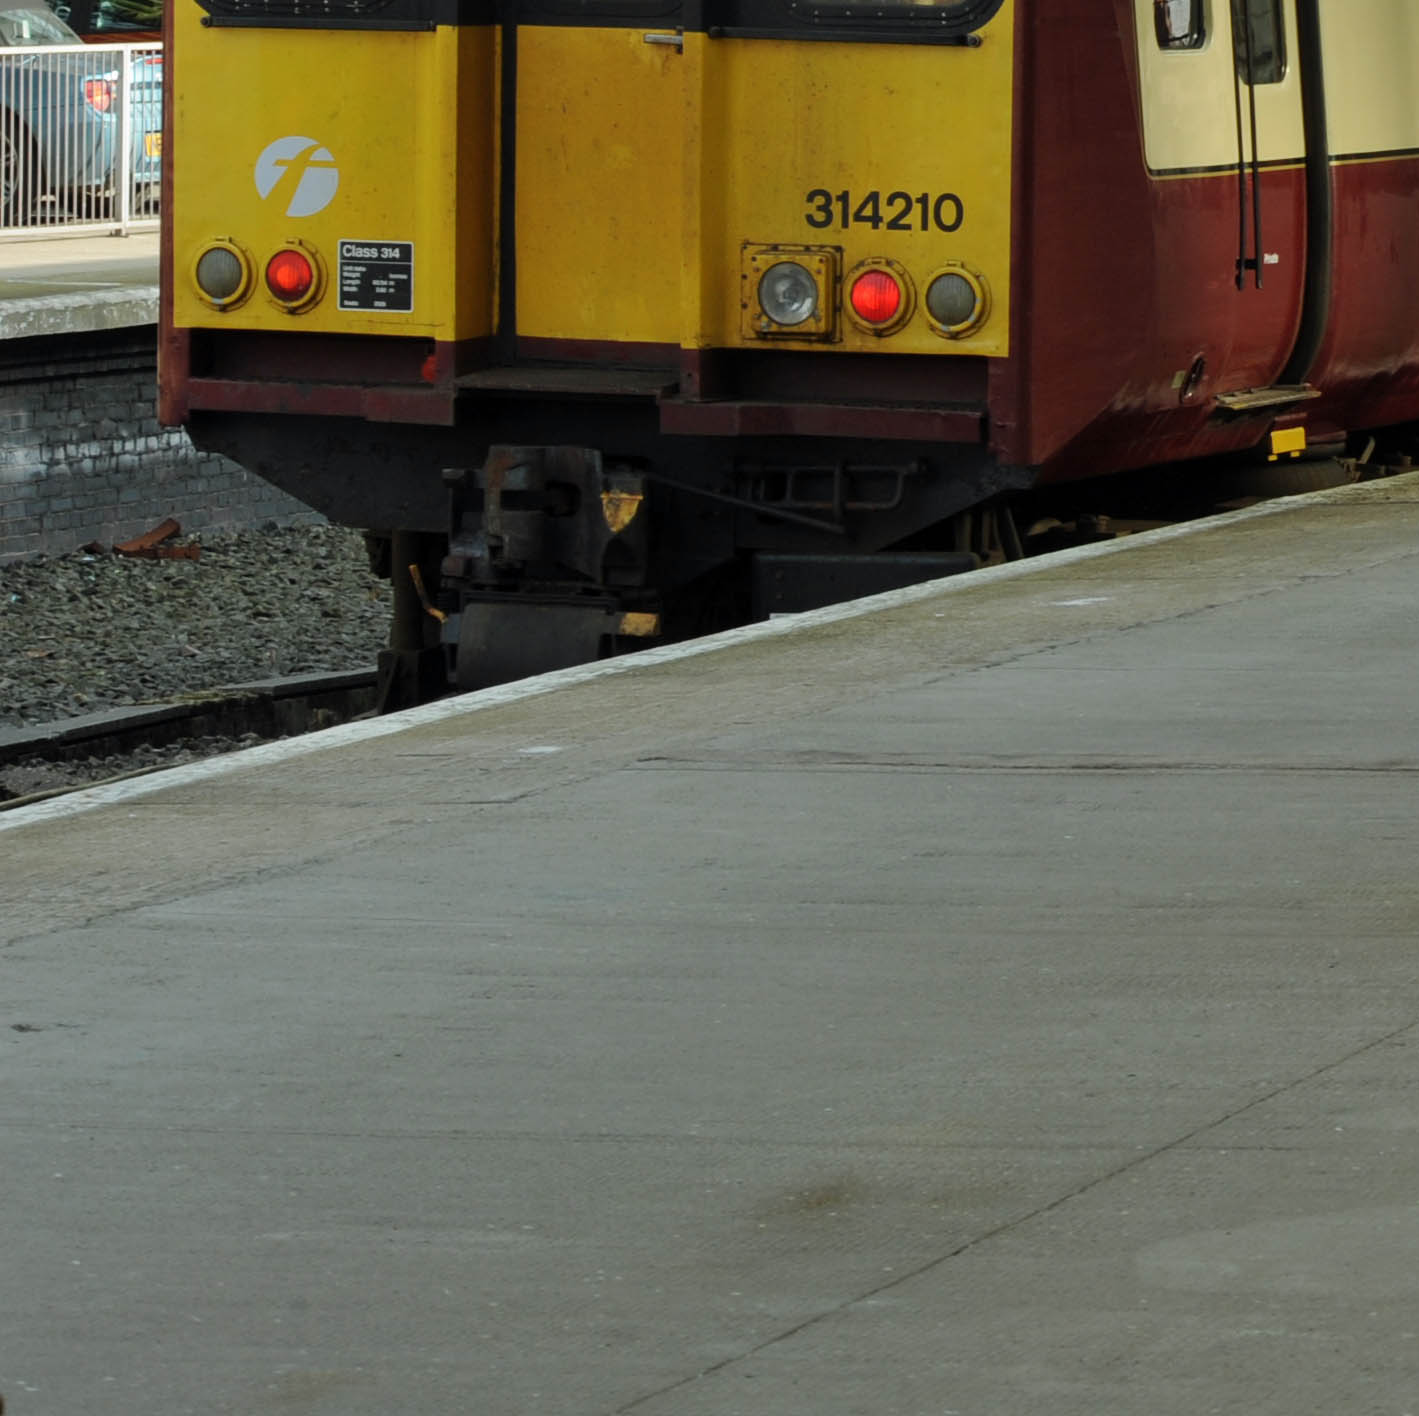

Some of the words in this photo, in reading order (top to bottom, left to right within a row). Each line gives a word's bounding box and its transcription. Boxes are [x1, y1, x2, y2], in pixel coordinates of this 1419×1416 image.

[804, 189, 964, 233] 314210
[342, 244, 379, 259] Class
[380, 247, 400, 259] 314
